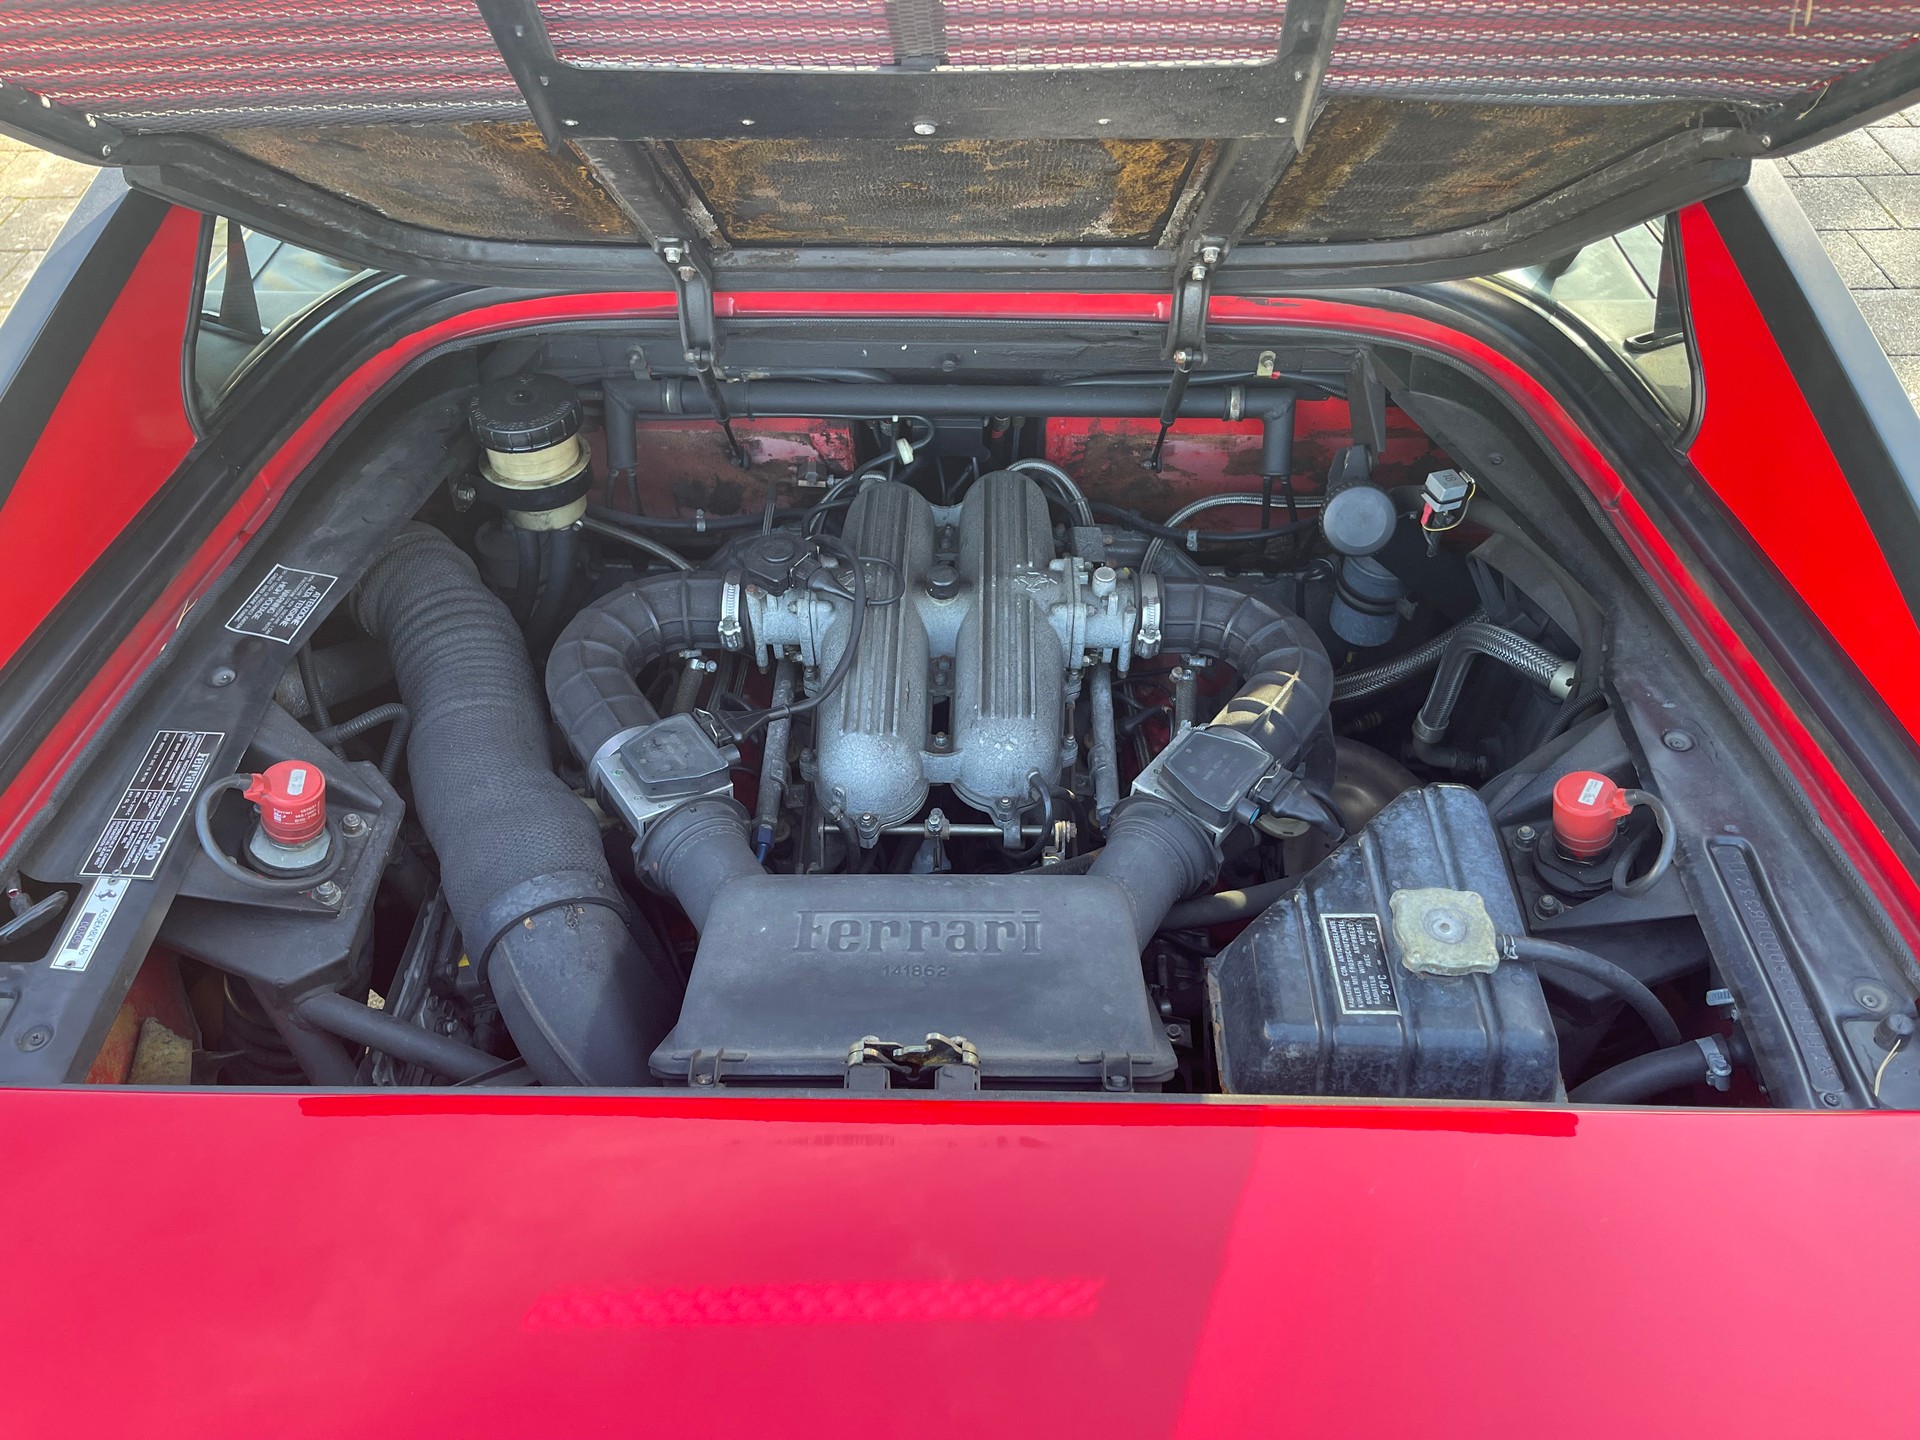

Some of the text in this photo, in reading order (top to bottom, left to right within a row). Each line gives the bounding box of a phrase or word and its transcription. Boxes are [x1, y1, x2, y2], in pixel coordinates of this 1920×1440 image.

[486, 419, 527, 431] POWER
[528, 400, 572, 428] STEERING
[250, 580, 288, 620] HIGH VOLTAGE
[265, 588, 291, 614] WARNING
[278, 584, 317, 627] ALTA TENSIONE
[289, 590, 322, 626] ATTENZIONE
[178, 752, 210, 792] Ferrari
[140, 835, 167, 860] Agip
[85, 908, 109, 942] ASSEMBLY
[792, 910, 1042, 954] Ferrari
[882, 964, 948, 977] 141862
[1347, 923, 1372, 1004] RADIATOR WITH ANTIFREEZE
[1355, 923, 1381, 1004] RADIATEUR AVEC ANTIGEL
